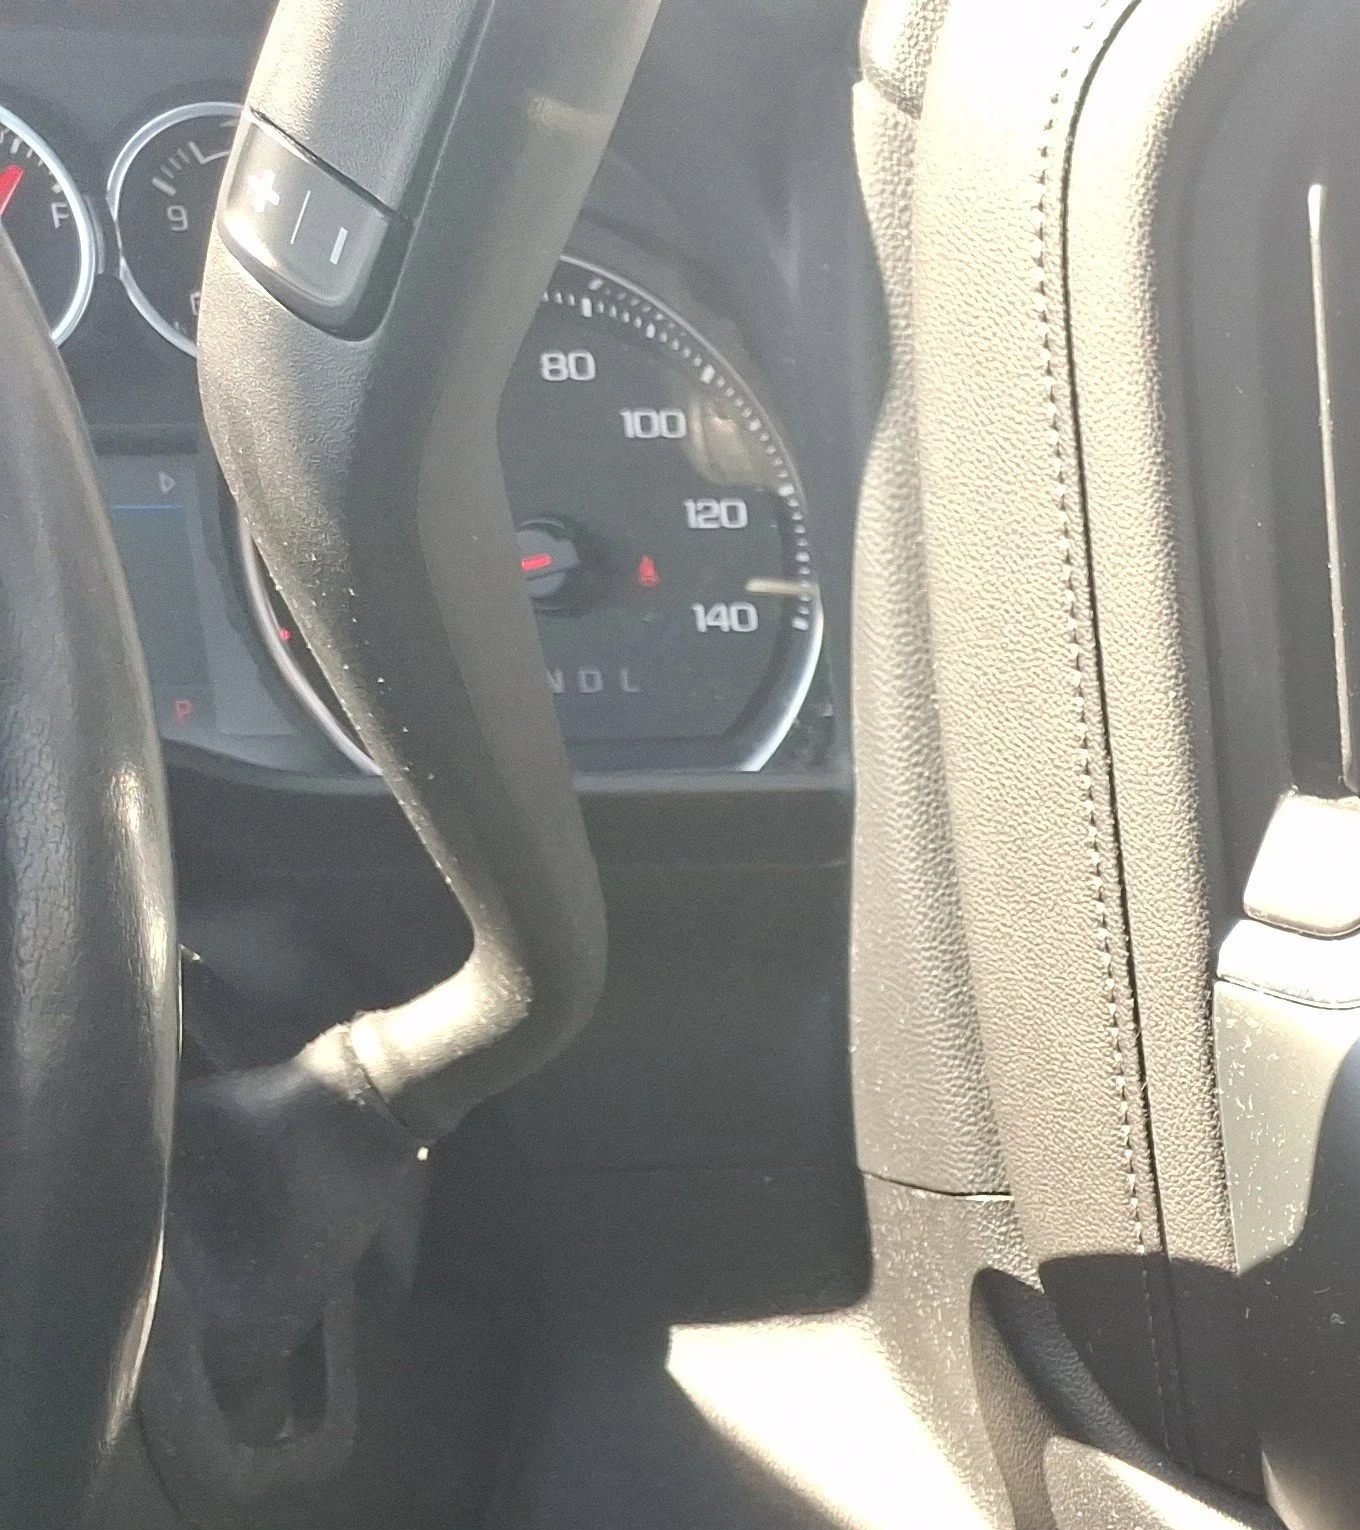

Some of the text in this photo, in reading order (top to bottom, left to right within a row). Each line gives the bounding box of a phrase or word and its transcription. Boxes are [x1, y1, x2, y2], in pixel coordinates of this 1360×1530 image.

[540, 350, 596, 381] 80
[618, 408, 687, 438] 100
[684, 499, 749, 529] 120
[692, 601, 759, 632] 140
